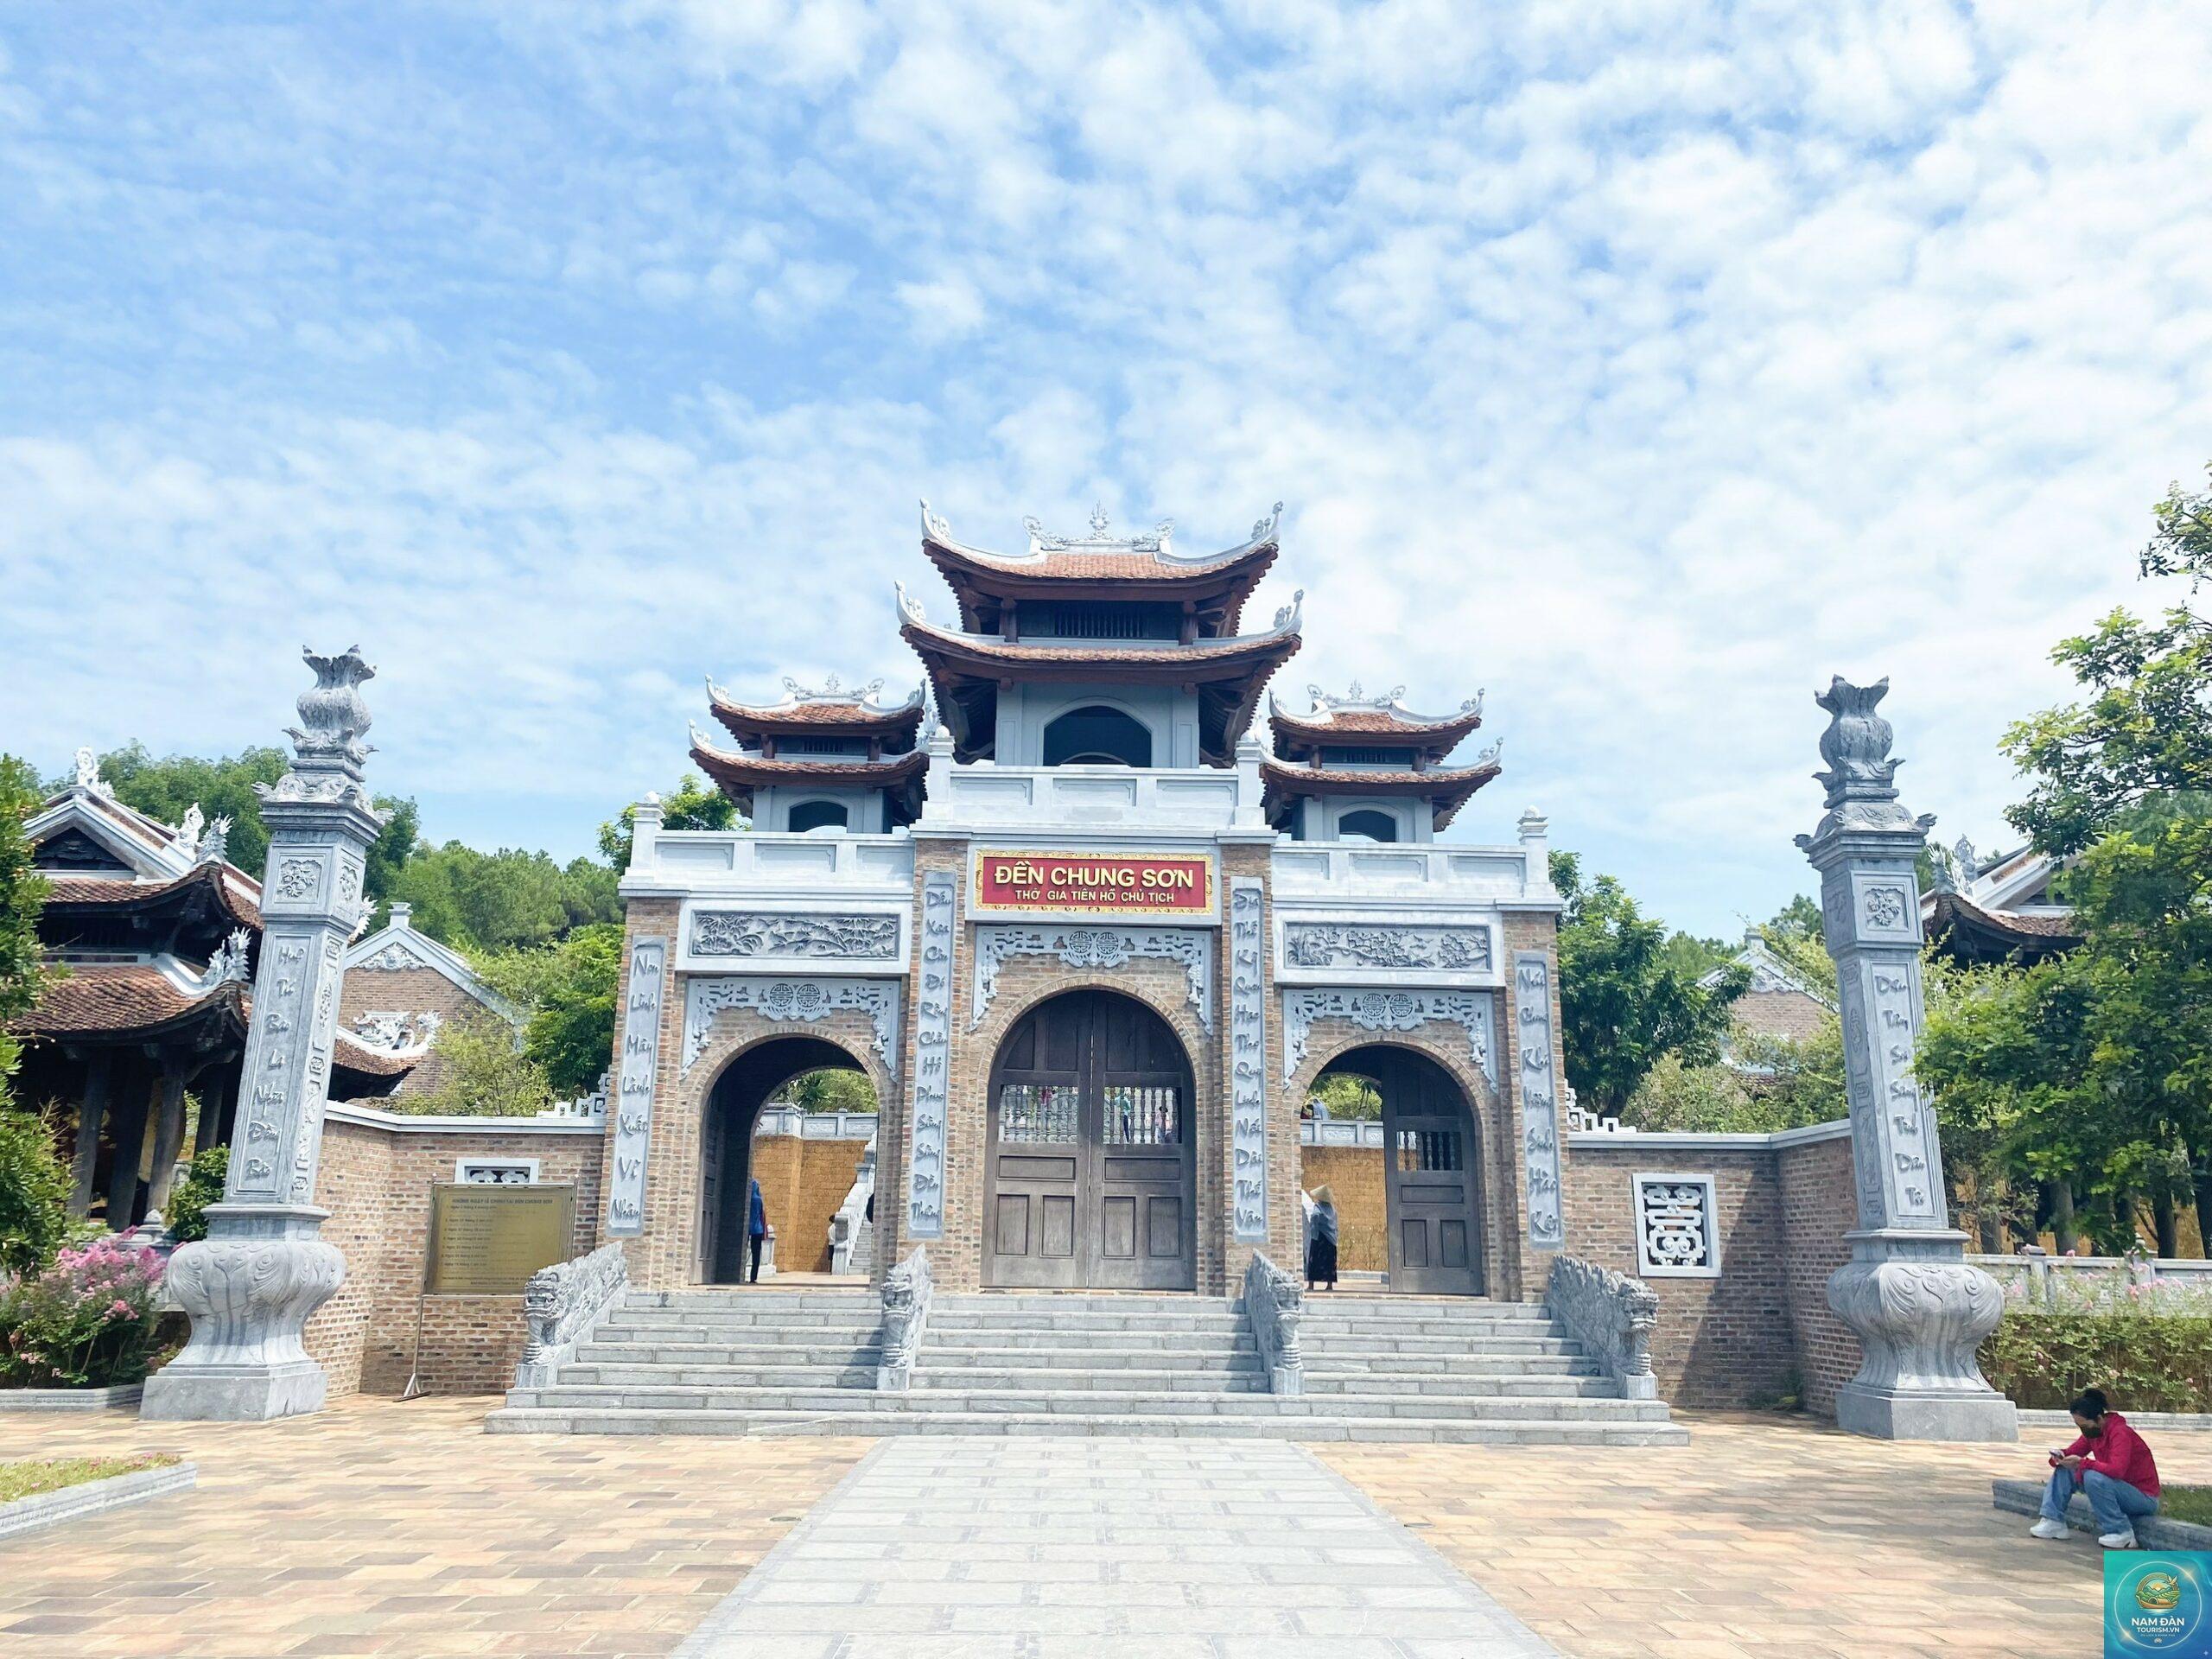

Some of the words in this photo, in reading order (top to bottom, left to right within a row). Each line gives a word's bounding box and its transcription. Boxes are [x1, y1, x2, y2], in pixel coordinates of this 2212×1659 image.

[995, 860, 1044, 885] ĐỀN
[1051, 868, 1135, 887] CHUNG
[1141, 869, 1193, 888] SƠN
[1015, 888, 1040, 900] THỜ
[1046, 890, 1067, 900] GIA
[1071, 889, 1096, 902] TIÊN
[1099, 888, 1116, 902] HỒ
[1121, 888, 1143, 902] CHỦ
[1148, 892, 1174, 905] TỊCH
[633, 954, 659, 977] Non
[626, 1033, 653, 1065] Mây
